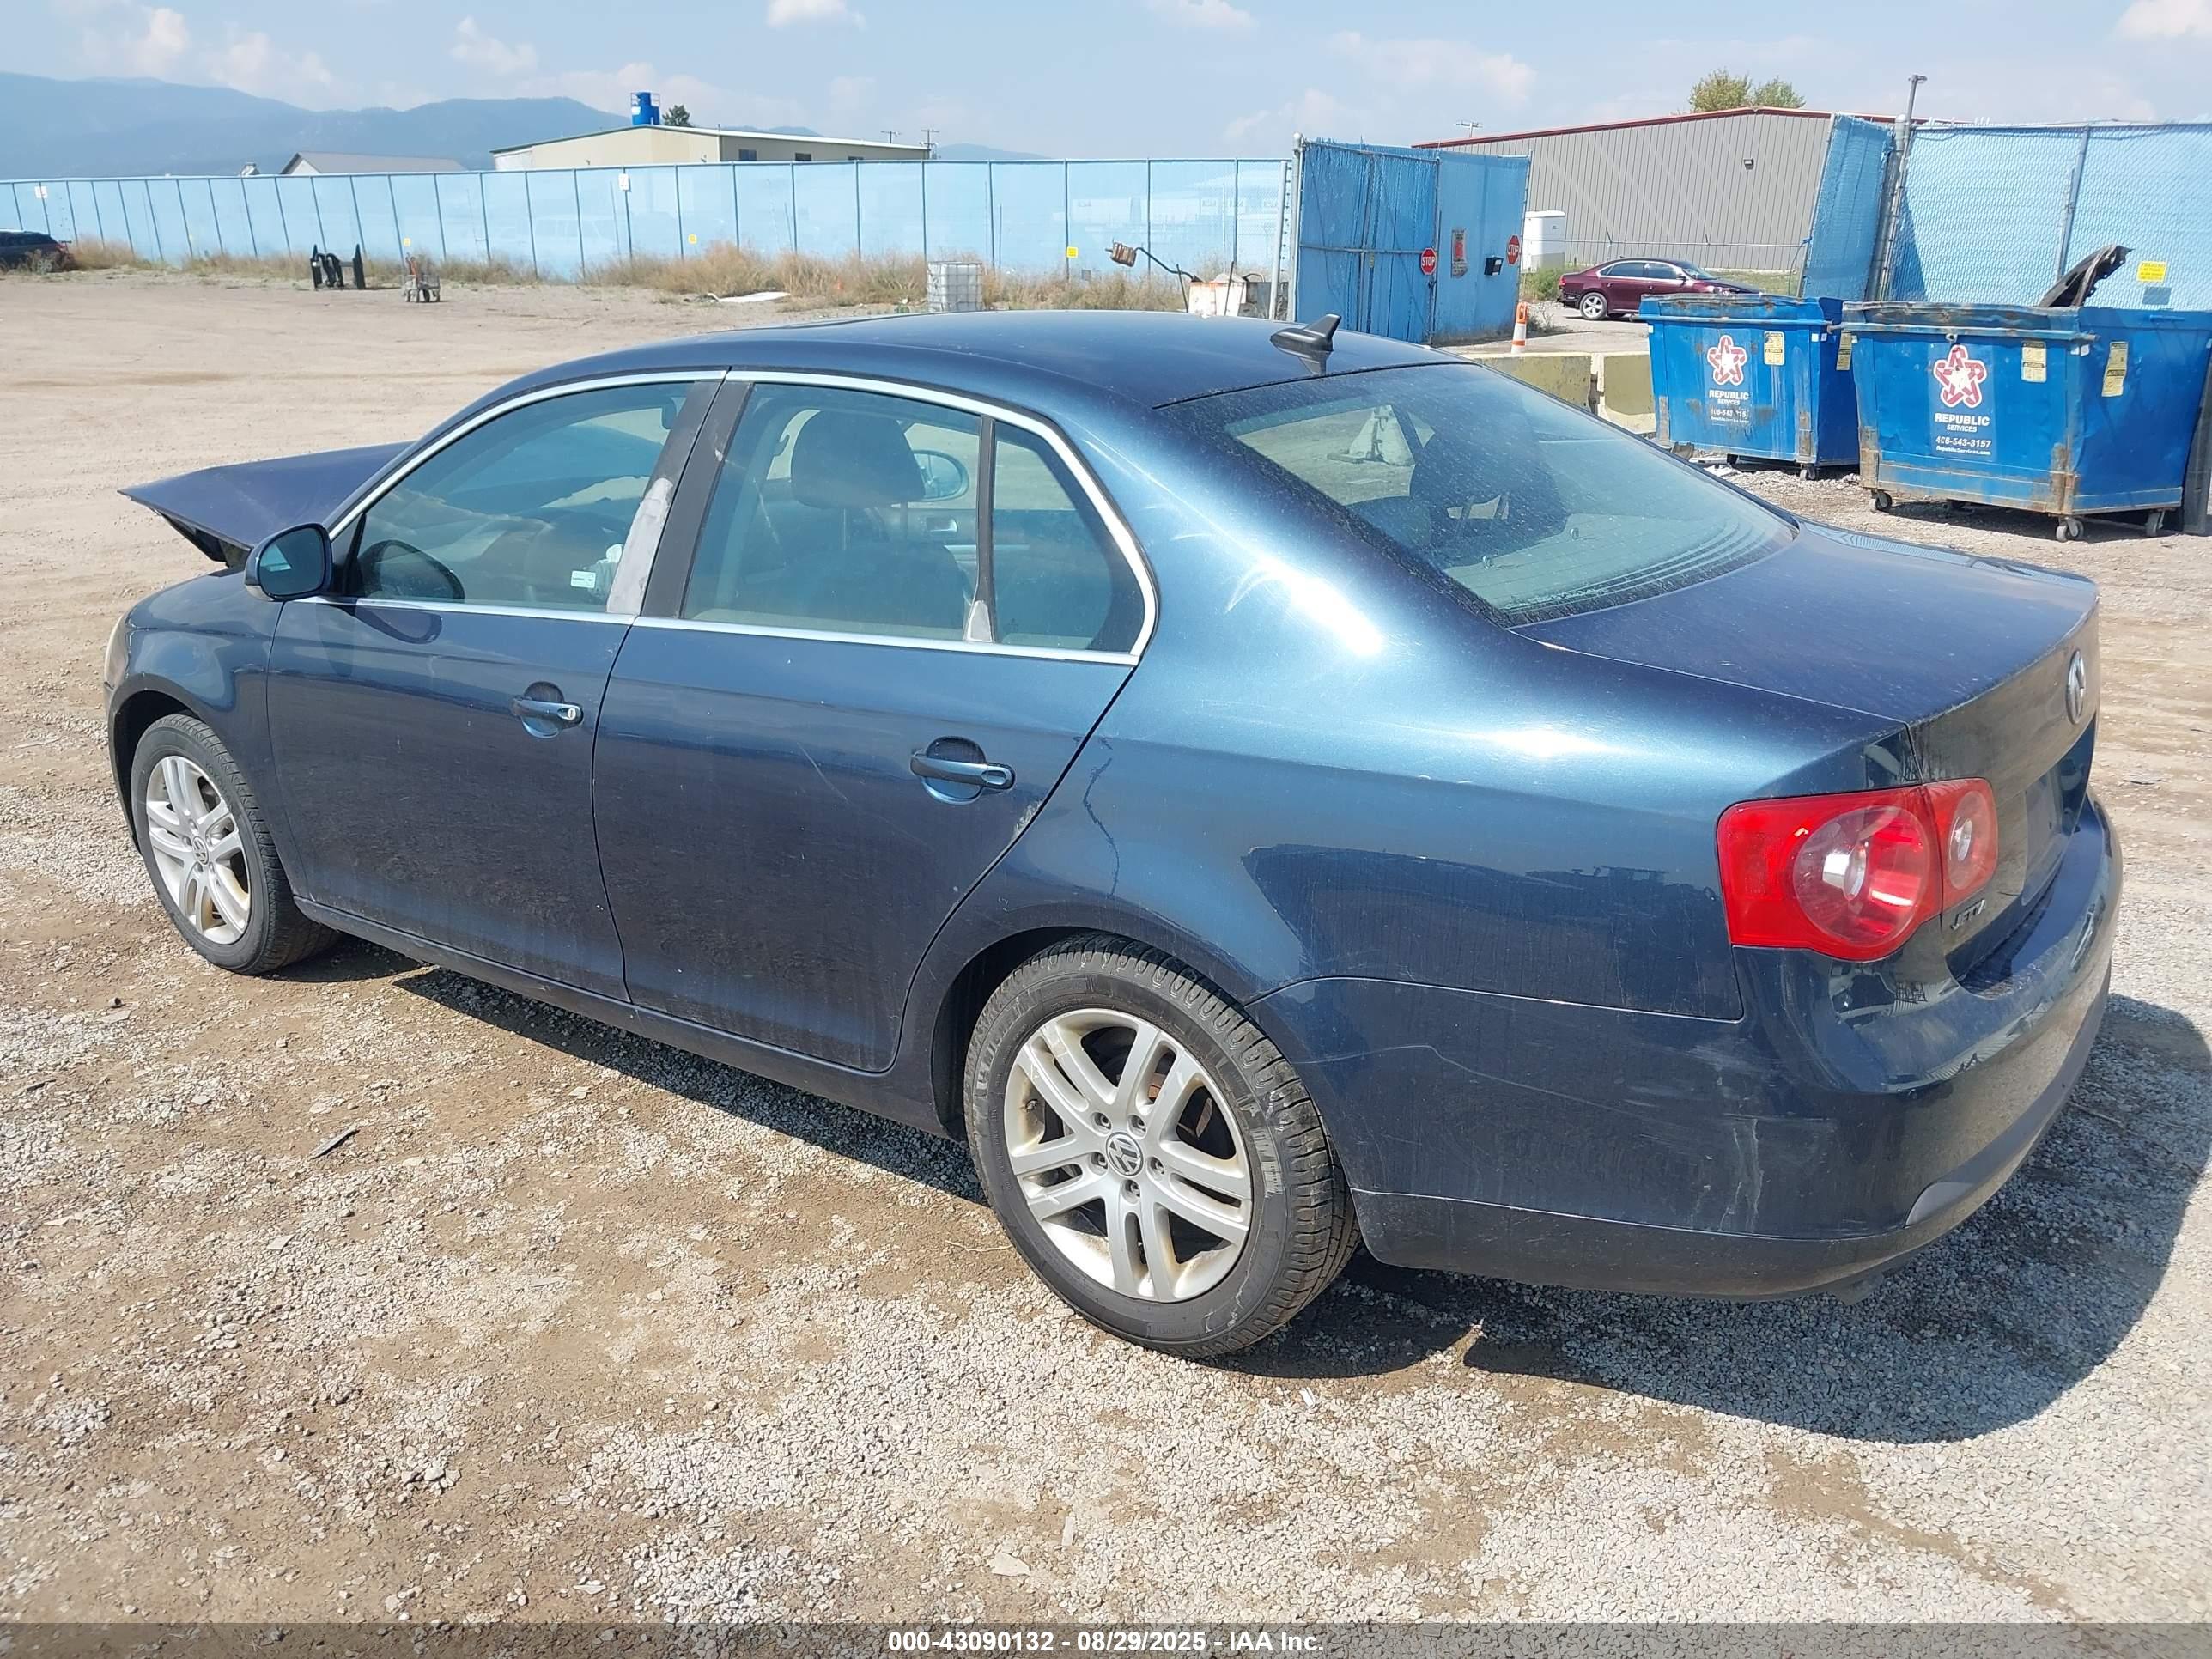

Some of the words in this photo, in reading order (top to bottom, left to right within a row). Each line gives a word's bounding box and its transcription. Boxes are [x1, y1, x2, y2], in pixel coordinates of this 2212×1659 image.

[1508, 244, 1519, 255] STOP
[1422, 256, 1436, 267] STOP
[1709, 389, 1750, 400] REPUBLIC
[1935, 412, 1990, 427] REPUBLIC
[1947, 424, 1978, 433] SERVICES
[1936, 435, 1992, 448] 406-543-3157
